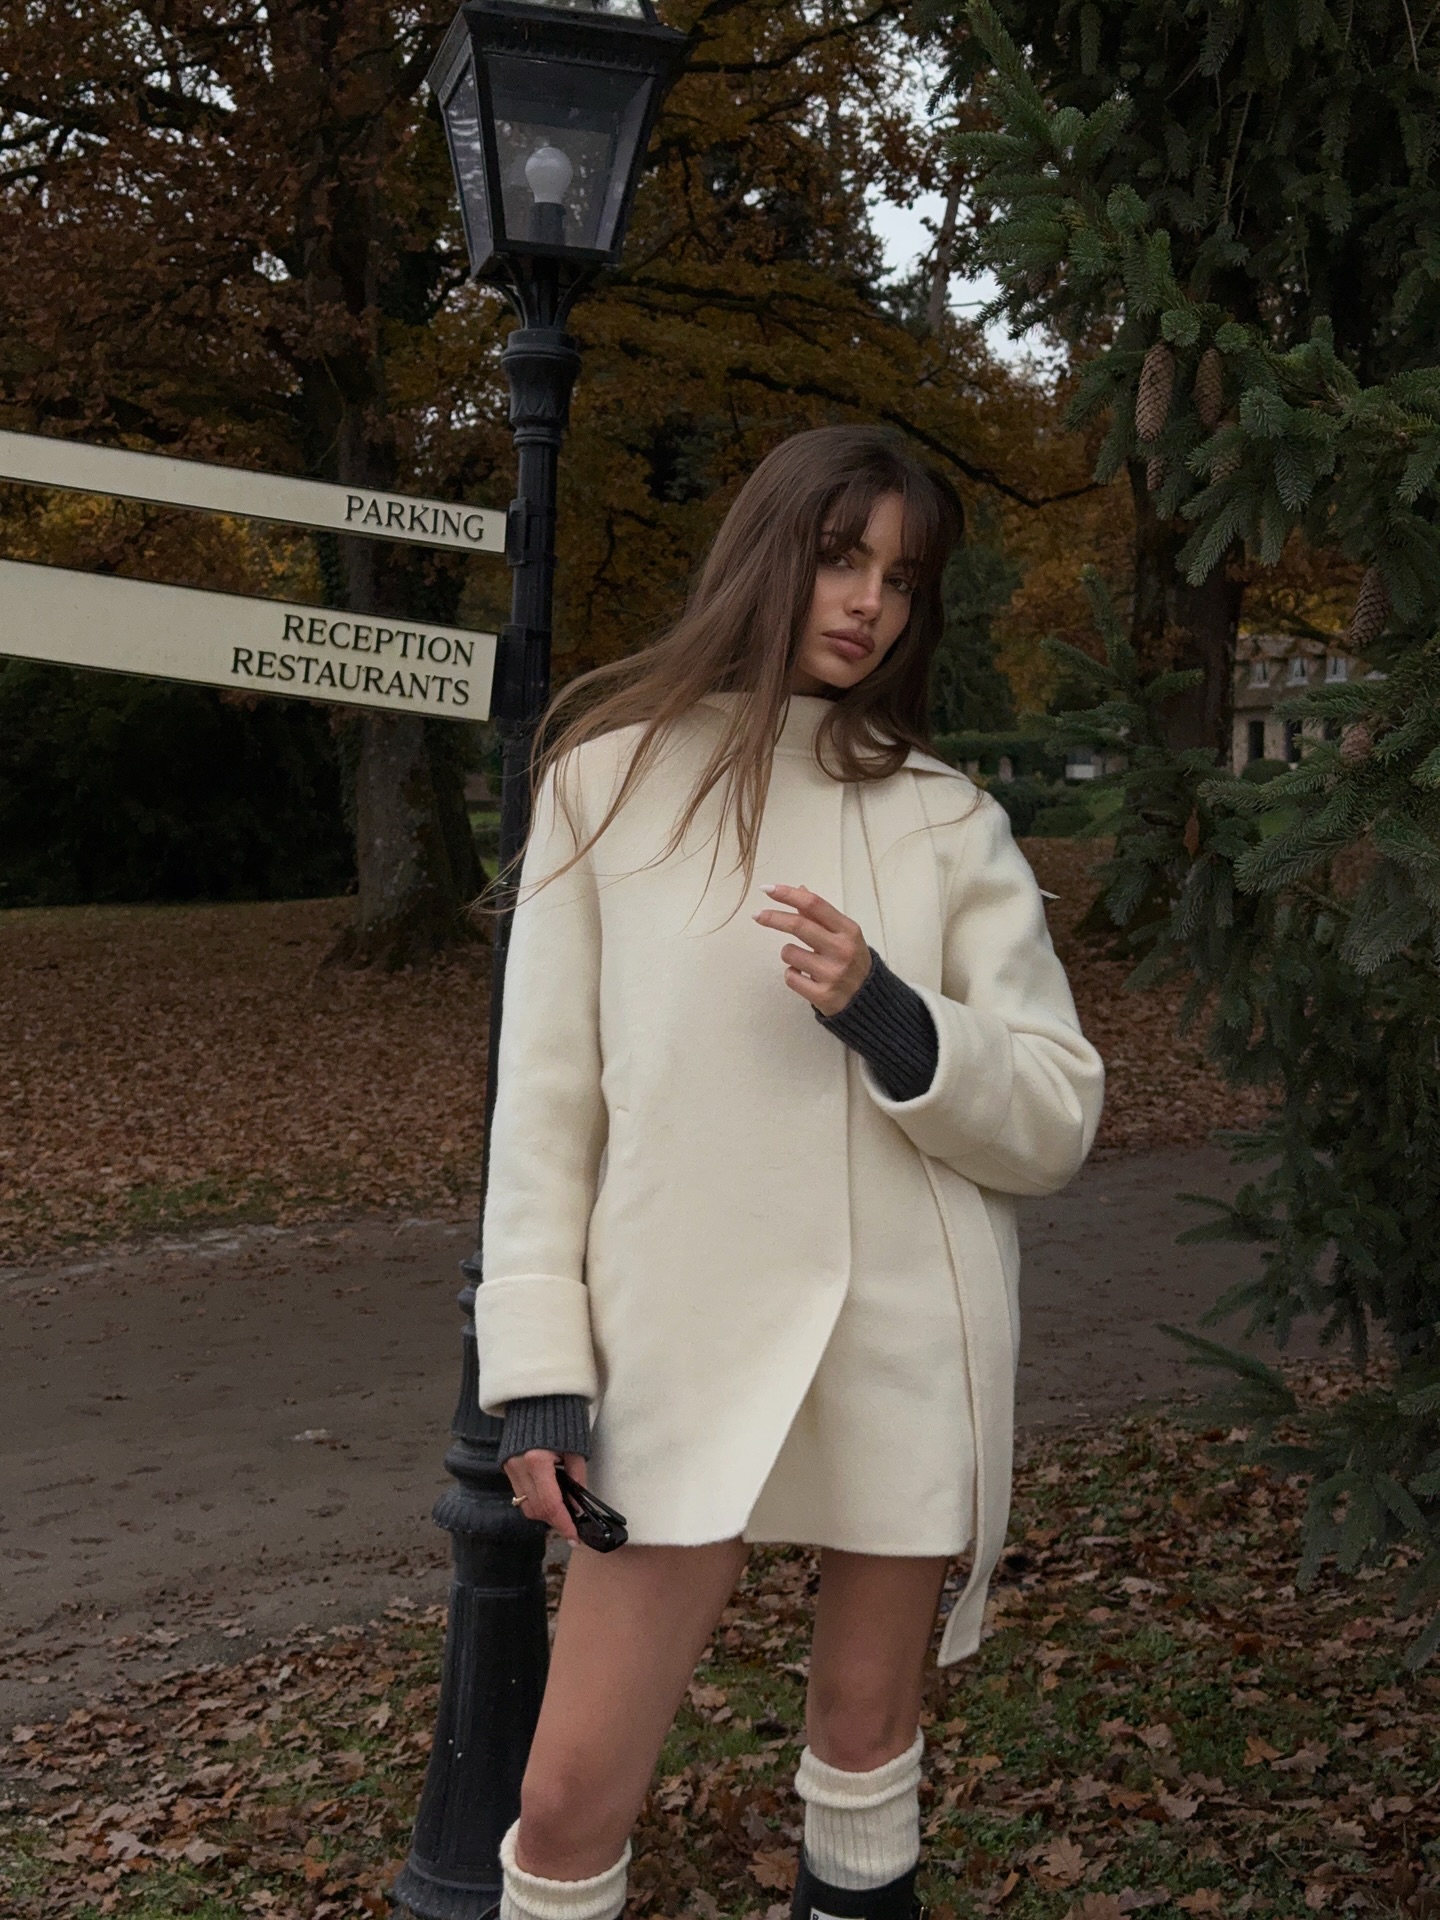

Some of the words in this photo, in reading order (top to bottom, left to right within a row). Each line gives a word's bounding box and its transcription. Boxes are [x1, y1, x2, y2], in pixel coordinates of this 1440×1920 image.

[344, 495, 484, 542] PARKING
[282, 614, 474, 666] RECEPTION
[231, 647, 470, 705] RESTAURANTS
